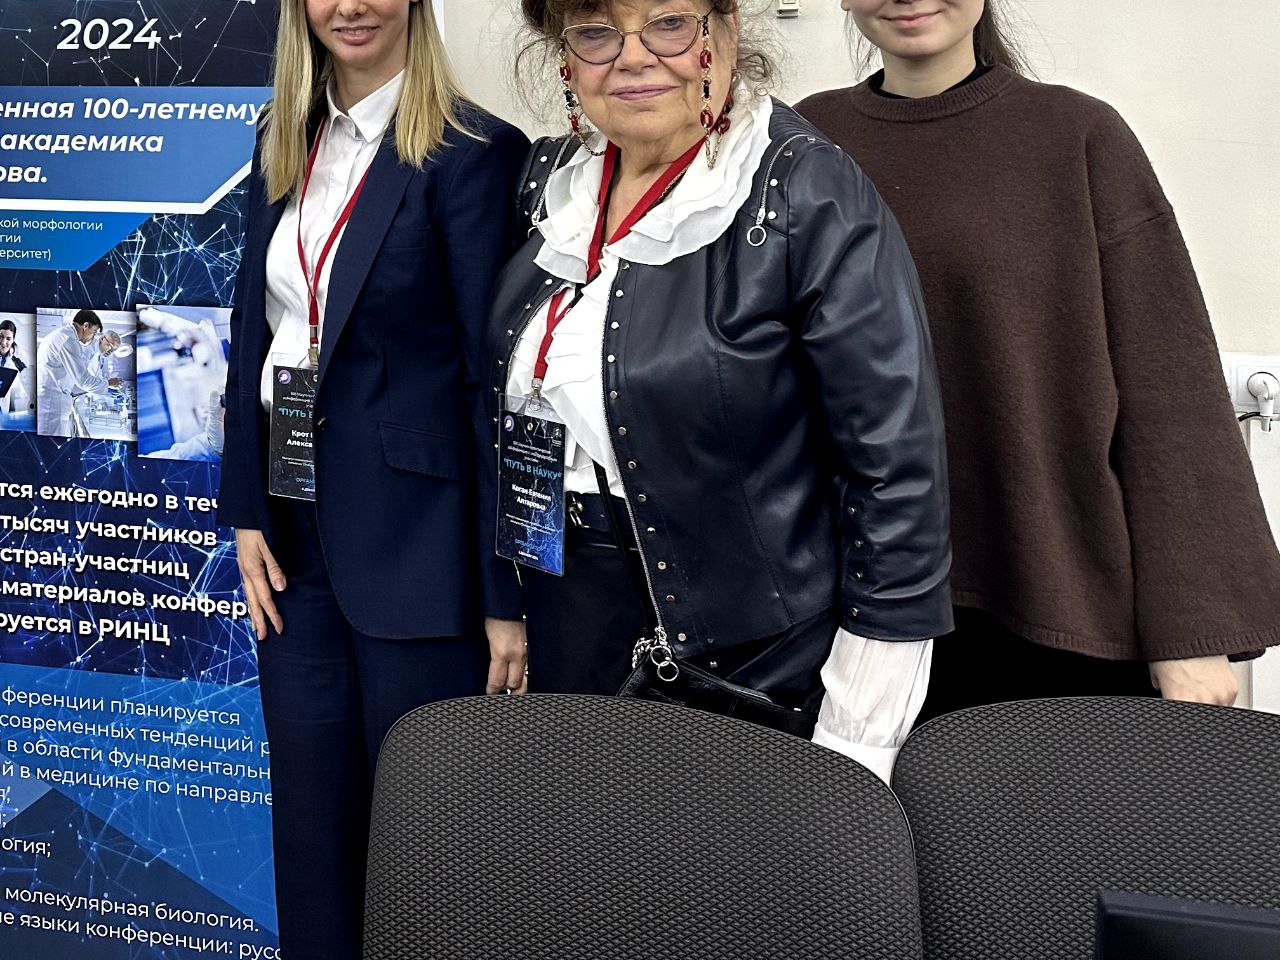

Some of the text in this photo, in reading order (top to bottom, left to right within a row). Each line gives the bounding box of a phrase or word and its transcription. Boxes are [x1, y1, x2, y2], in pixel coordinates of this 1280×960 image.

[56, 18, 162, 50] 2024
[83, 97, 266, 126] 100-летнему
[0, 131, 163, 154] академика
[22, 218, 104, 234] морфологии
[526, 464, 532, 473] В
[39, 484, 158, 510] ежегодно
[165, 494, 179, 510] в
[0, 515, 70, 535] тысяч
[75, 519, 217, 547] участников
[0, 547, 190, 580] стран-участниц
[1, 578, 146, 608] материалов
[152, 592, 251, 621] конфер
[78, 618, 93, 635] в
[99, 619, 171, 646] РИНЦ
[110, 699, 240, 727] планируется
[7, 738, 18, 753] в
[23, 737, 103, 762] области
[140, 725, 254, 754] тенденций
[20, 764, 31, 779] в
[36, 766, 140, 793] медицине
[144, 779, 170, 795] по
[5, 887, 150, 919] молекулярная
[154, 902, 259, 933] биология.
[20, 913, 80, 934] языки
[86, 920, 234, 955] конференции:
